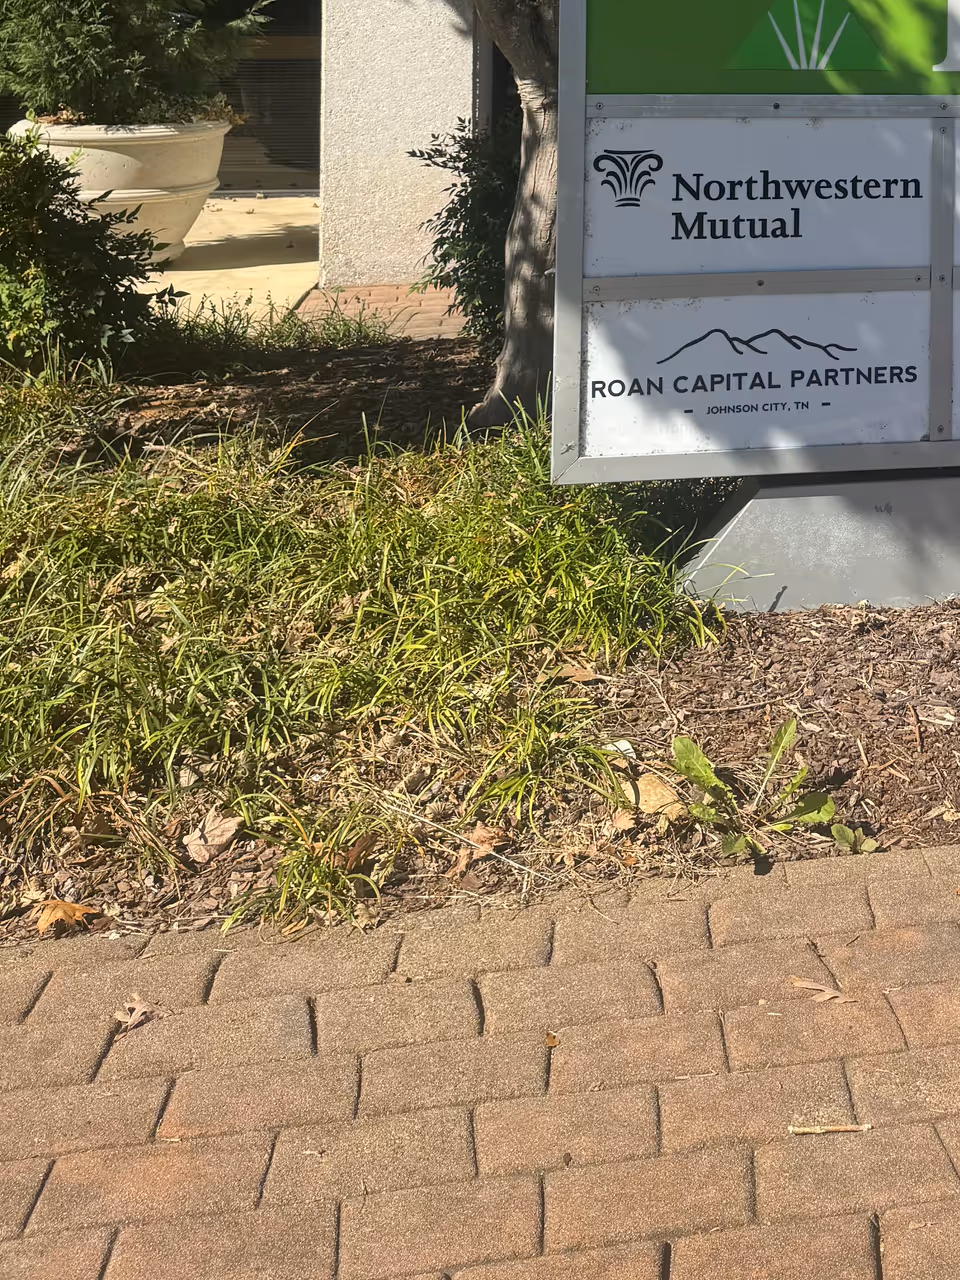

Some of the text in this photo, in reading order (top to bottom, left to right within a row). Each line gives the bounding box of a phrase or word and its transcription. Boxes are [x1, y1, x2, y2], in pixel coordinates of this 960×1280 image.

[672, 170, 924, 201] Northwestern
[671, 207, 803, 240] Mutual
[591, 365, 918, 399] ROAN CAPITAL PARTNERS
[706, 401, 809, 416] JOHNSON CITY, TN
